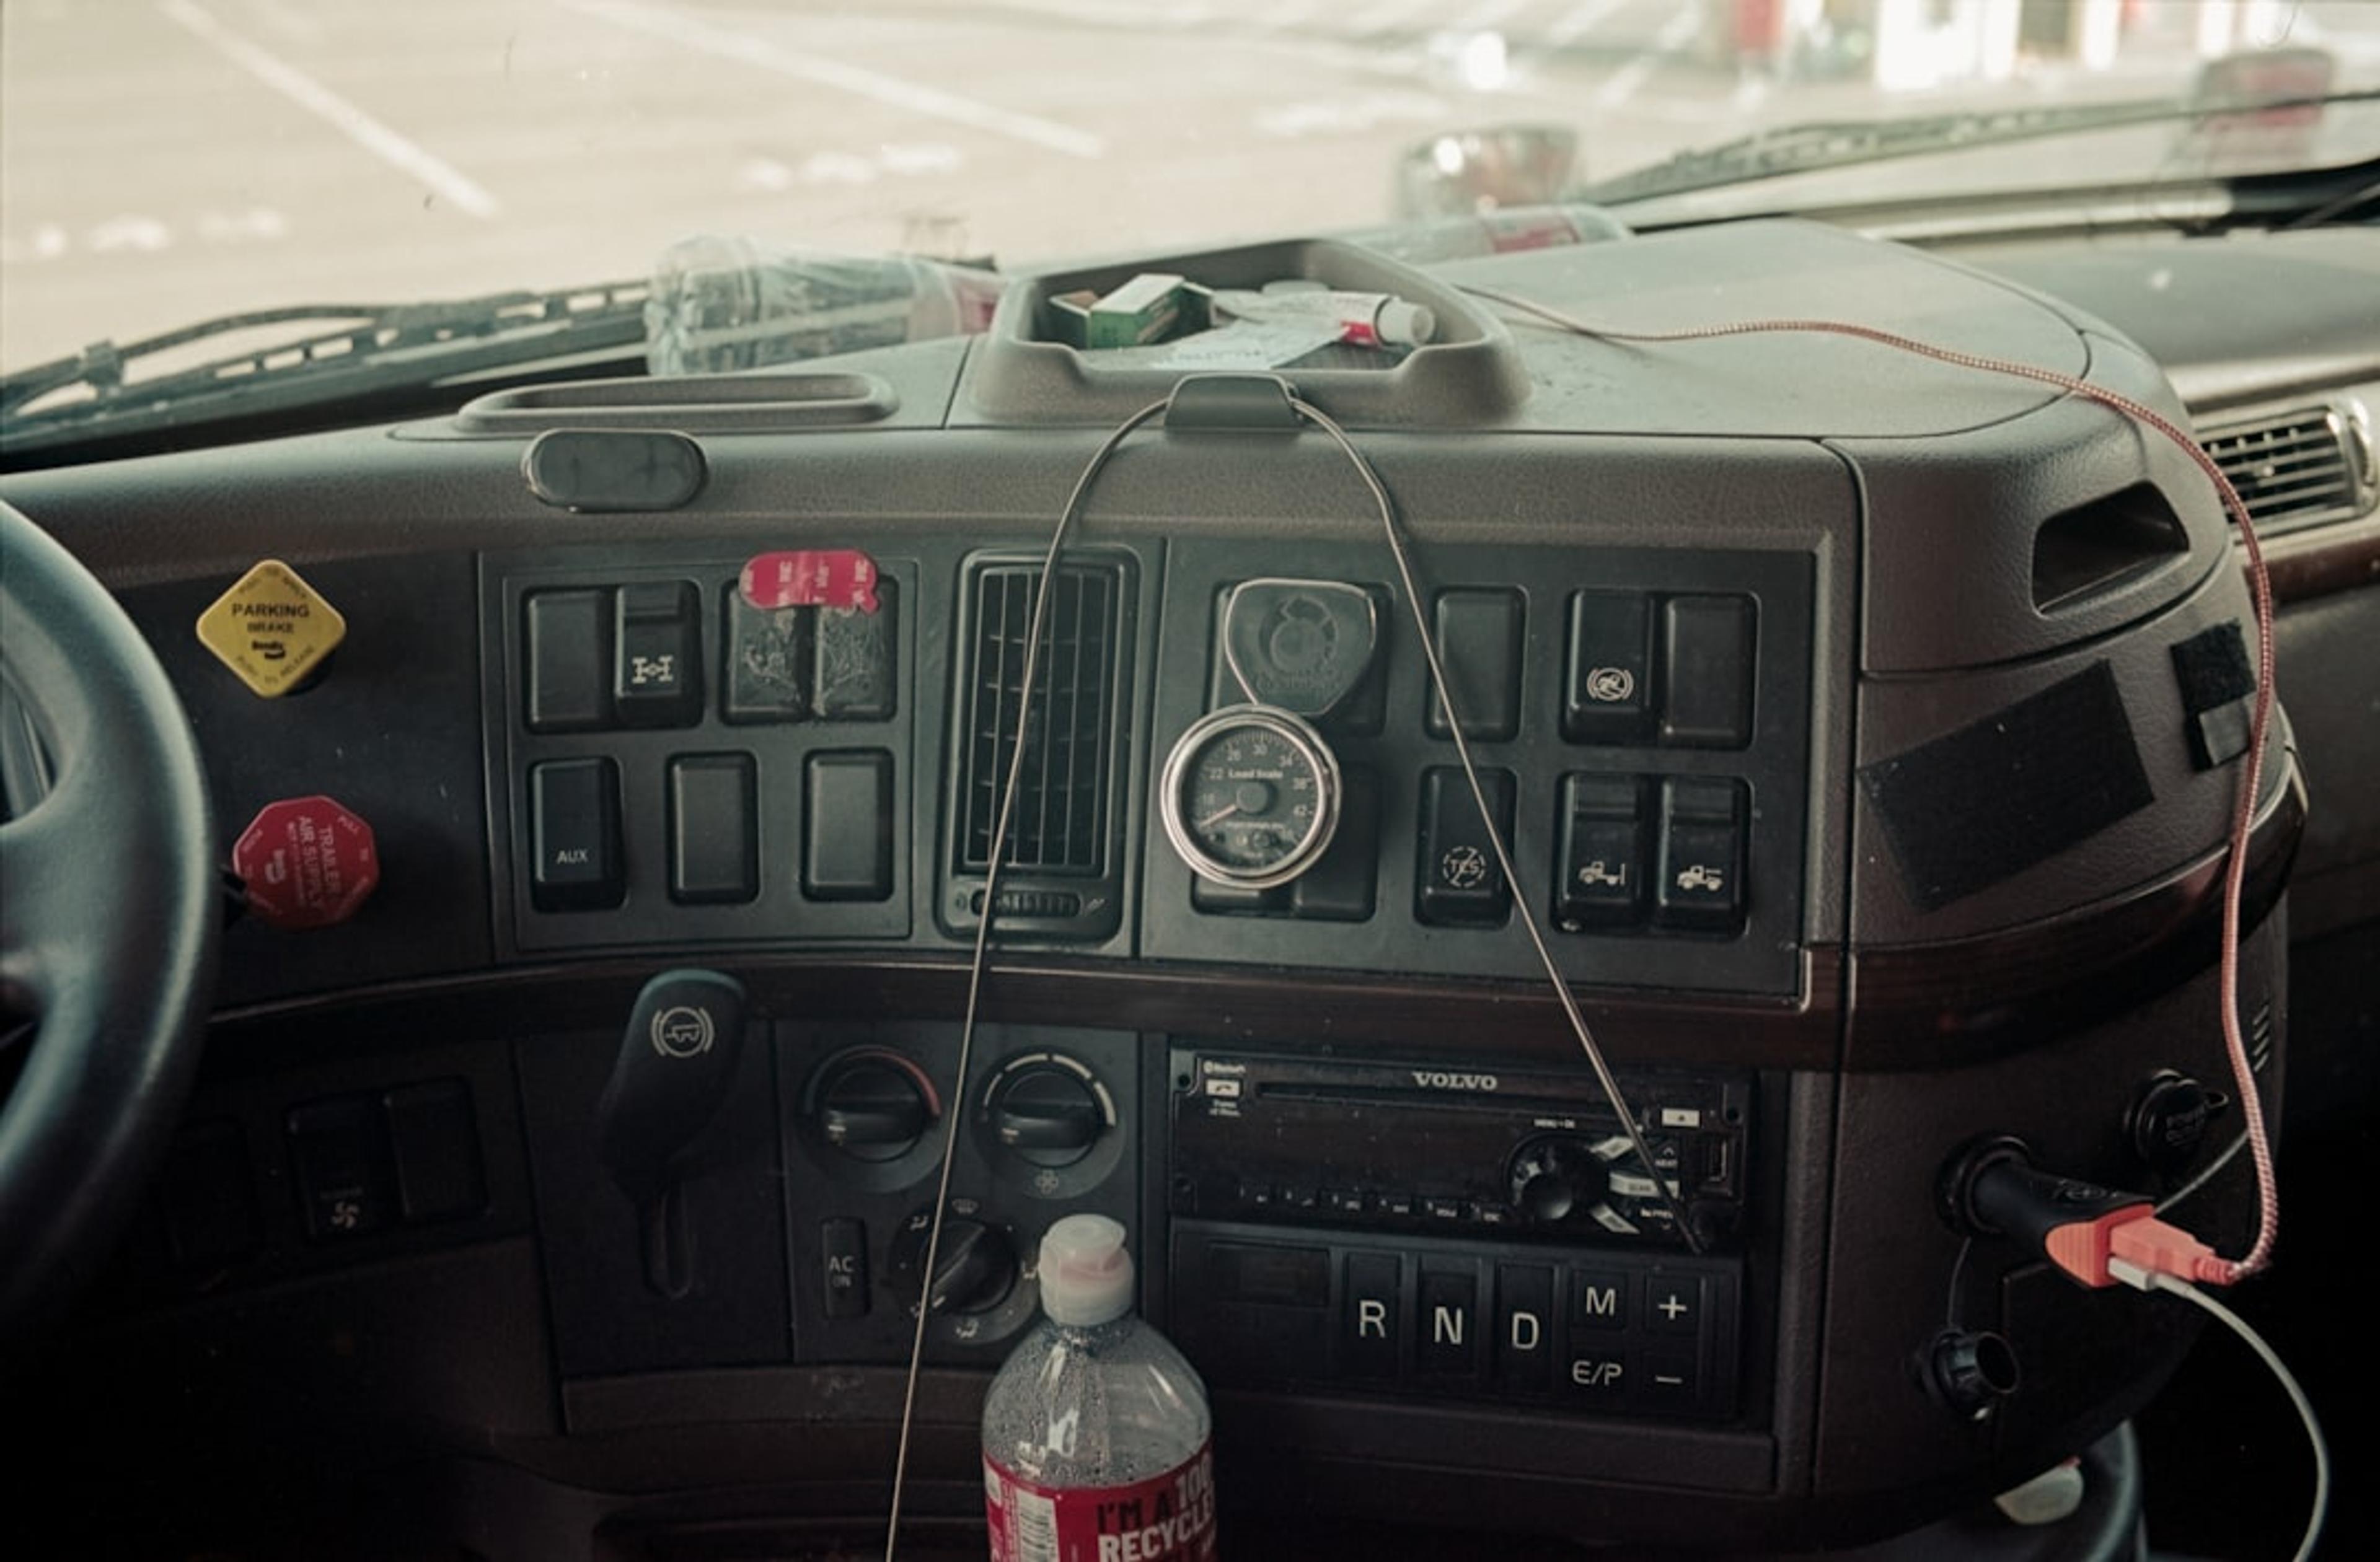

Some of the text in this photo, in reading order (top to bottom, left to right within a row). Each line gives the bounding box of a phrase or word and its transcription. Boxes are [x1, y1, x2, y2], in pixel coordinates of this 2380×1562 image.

[231, 603, 309, 618] PARKING
[248, 621, 294, 634] BRAKE
[1253, 745, 1267, 755] 30
[1228, 769, 1255, 779] Load
[556, 849, 589, 865] AUX
[1411, 1071, 1498, 1091] VOLVO
[829, 1255, 855, 1273] AC
[832, 1275, 852, 1288] ON
[1585, 1286, 1616, 1317] M
[1359, 1299, 1386, 1338] R
[1434, 1305, 1463, 1345] N
[1510, 1310, 1541, 1349] D
[1571, 1359, 1624, 1387] E/P
[1097, 1497, 1142, 1534] I'M
[1153, 1488, 1171, 1523] A
